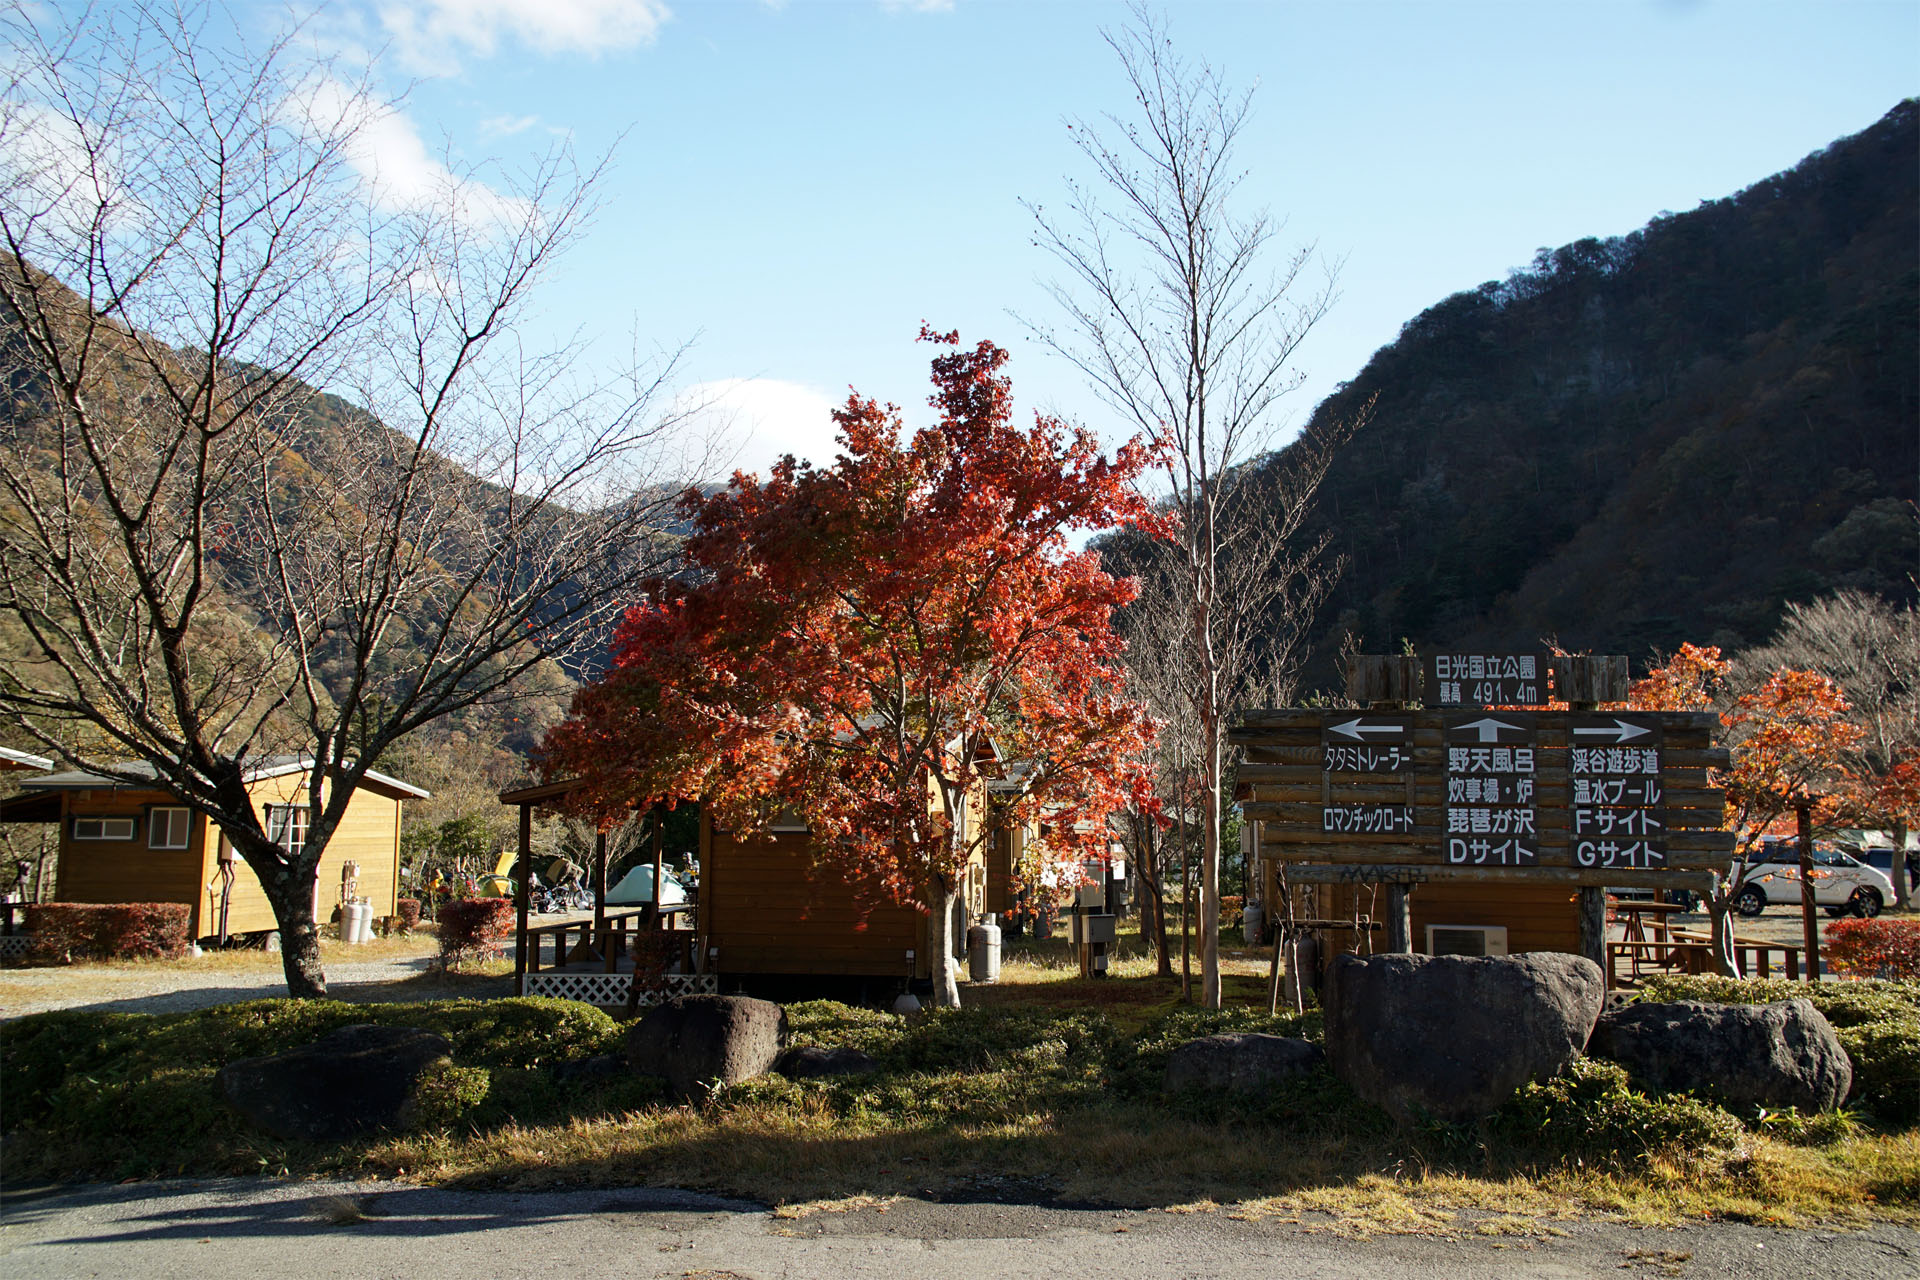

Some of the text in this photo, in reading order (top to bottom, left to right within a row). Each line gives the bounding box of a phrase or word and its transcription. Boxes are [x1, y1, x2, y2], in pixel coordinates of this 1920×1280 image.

[1436, 655, 1536, 679] 日光国立公園
[1325, 746, 1410, 771] タタミトレーラー
[1448, 747, 1534, 772] 野天風呂
[1572, 748, 1659, 774] 渓谷遊歩道
[1448, 777, 1533, 803] 炊事場・炉
[1574, 779, 1660, 804] 温水プール
[1324, 807, 1413, 832] ロマンチックロード
[1448, 808, 1535, 833] 琵琶が沢
[1576, 809, 1661, 835] Fサイト
[1449, 838, 1534, 864] Dサイト
[1577, 841, 1663, 867] Gサイト
